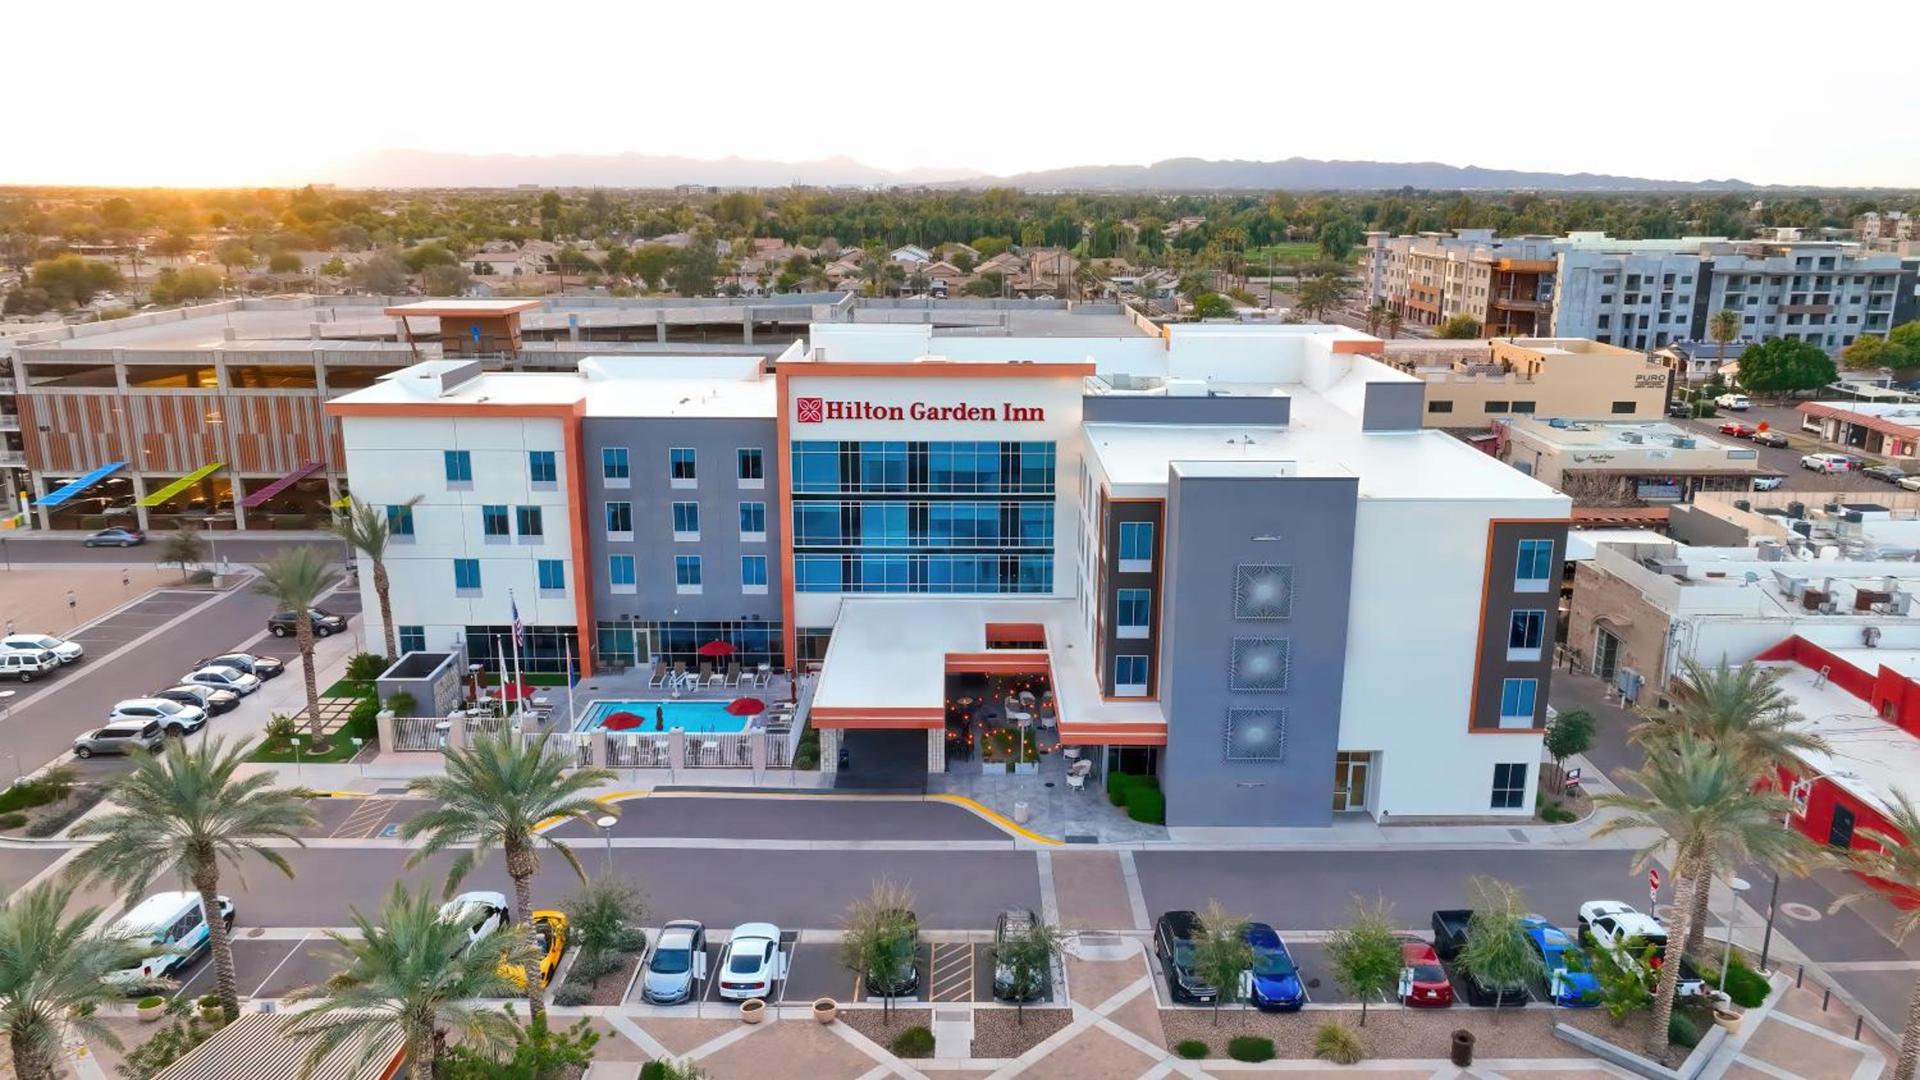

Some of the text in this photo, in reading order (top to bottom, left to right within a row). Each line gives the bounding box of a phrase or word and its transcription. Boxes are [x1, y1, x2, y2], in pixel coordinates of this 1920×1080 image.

[825, 401, 1045, 421] Hilton Garden Inn
